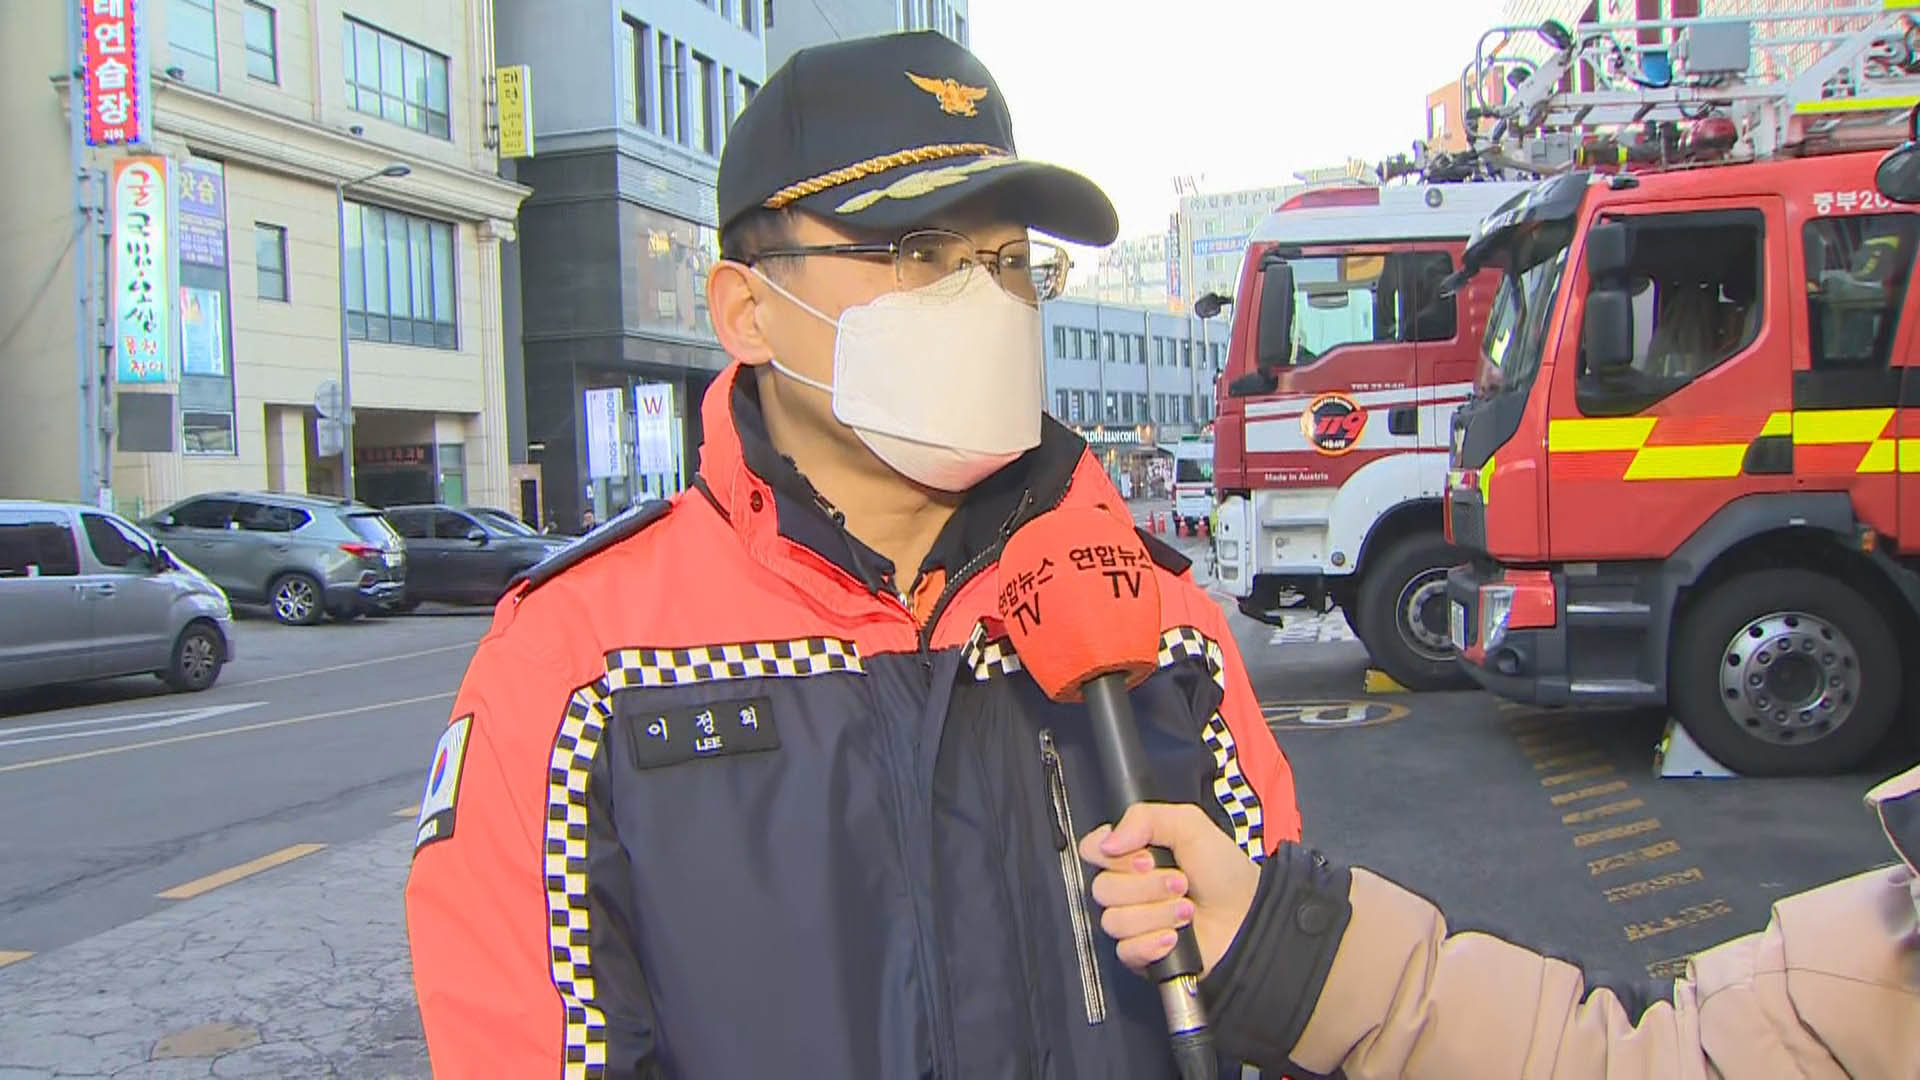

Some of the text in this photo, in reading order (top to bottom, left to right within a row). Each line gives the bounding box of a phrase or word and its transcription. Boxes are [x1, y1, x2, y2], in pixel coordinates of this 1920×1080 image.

[1314, 409, 1369, 441] 119
[1264, 472, 1287, 481] Made
[1299, 471, 1329, 481] Austria
[1068, 544, 1153, 571] 연합뉴스
[1102, 570, 1141, 599] TV
[1012, 591, 1042, 636] TV
[695, 735, 724, 752] LEE
